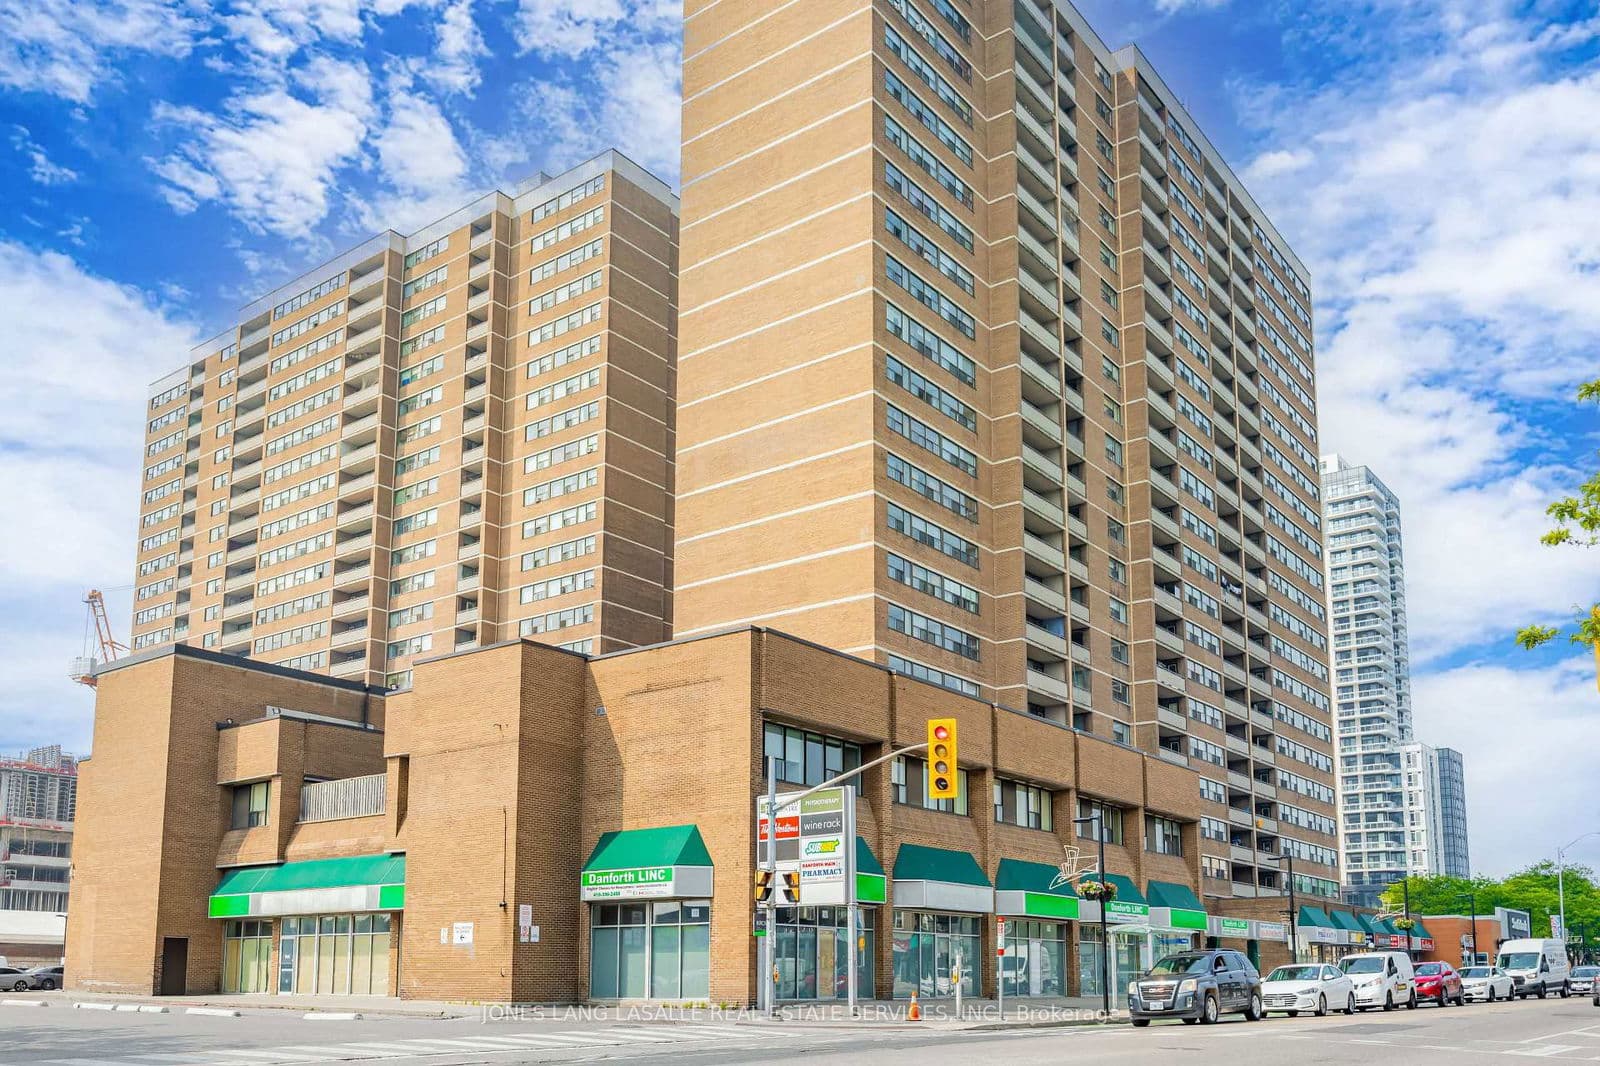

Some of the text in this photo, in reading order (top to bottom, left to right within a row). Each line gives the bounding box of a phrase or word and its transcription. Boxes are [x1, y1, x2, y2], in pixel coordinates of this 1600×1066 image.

[823, 817, 841, 829] rack
[589, 870, 665, 884] Danforth LINC
[802, 868, 843, 877] PHARMACY
[1111, 903, 1131, 912] Danforth
